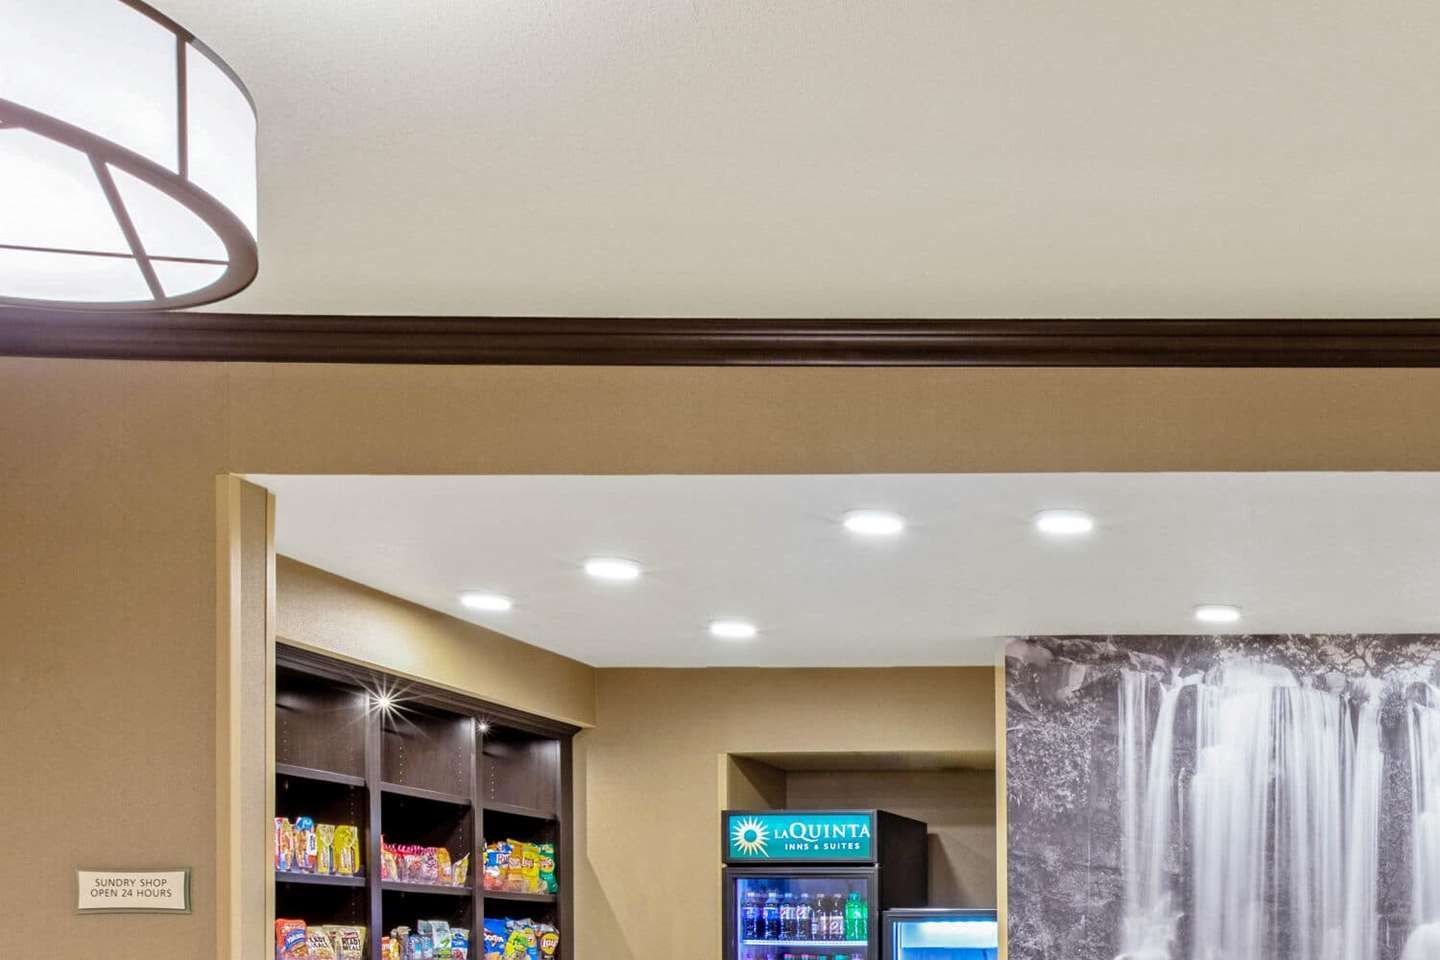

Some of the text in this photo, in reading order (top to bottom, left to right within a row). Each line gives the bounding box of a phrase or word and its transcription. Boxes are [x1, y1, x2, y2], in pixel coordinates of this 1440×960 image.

[784, 843, 809, 851] INNS
[95, 878, 168, 888] SUNDRY SHOP
[90, 888, 172, 898] OPEN 24 HOURS
